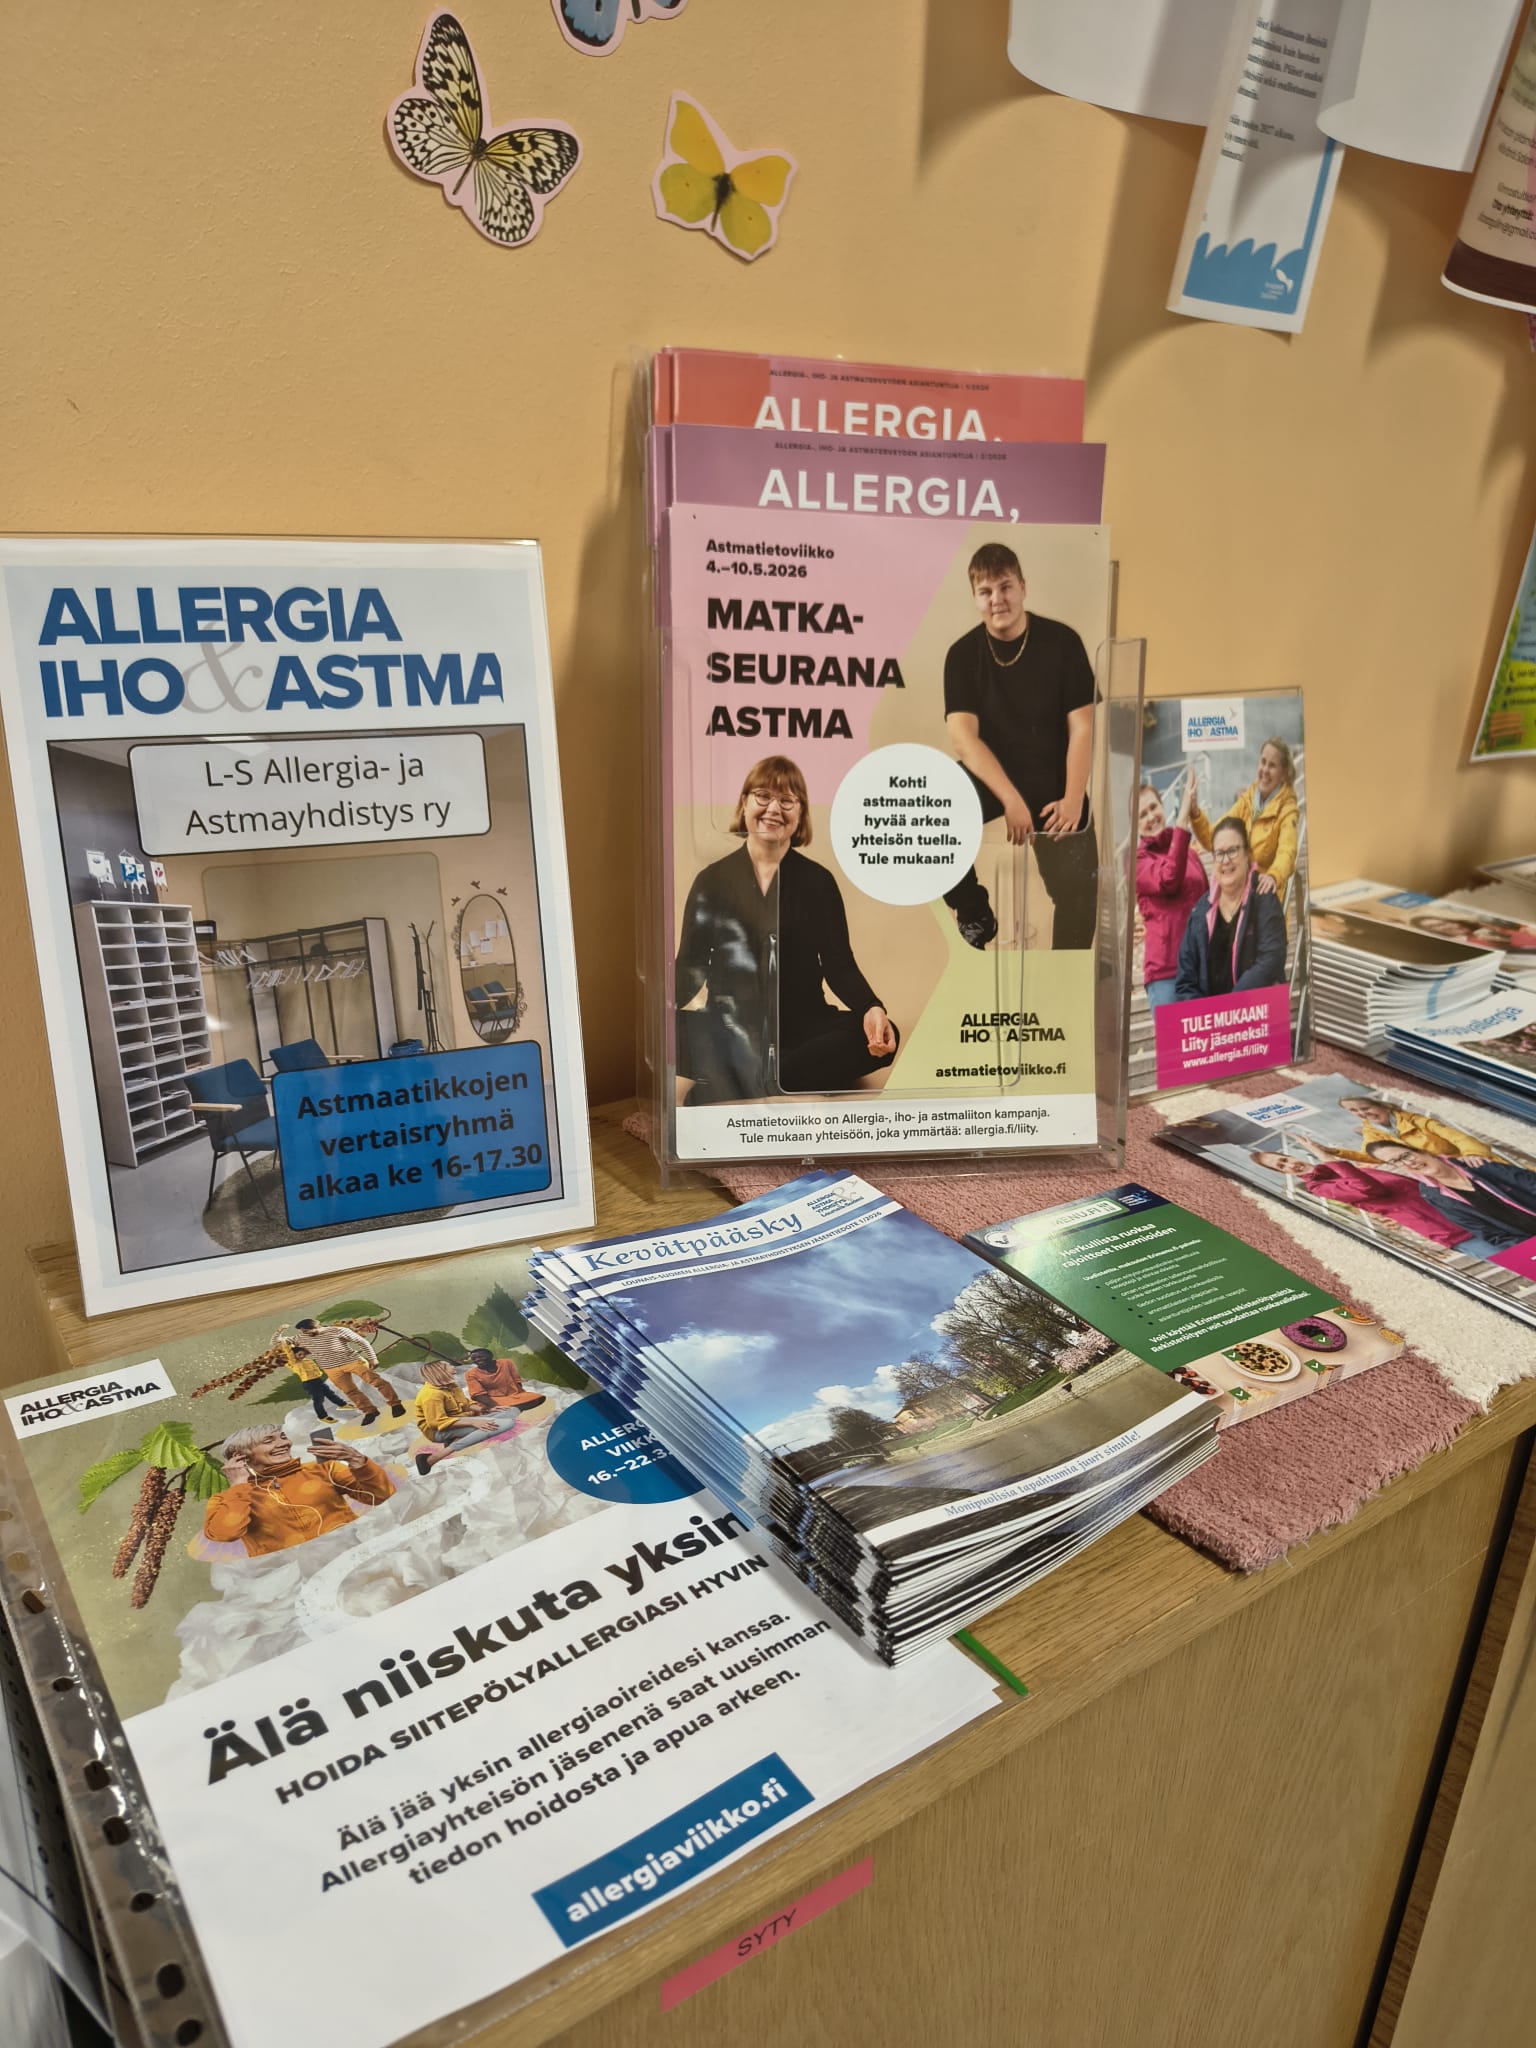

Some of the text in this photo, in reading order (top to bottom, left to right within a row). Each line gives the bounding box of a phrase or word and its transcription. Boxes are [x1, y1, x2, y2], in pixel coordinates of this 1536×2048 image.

[758, 468, 1020, 524] ALLERGIA,
[705, 538, 835, 560] Astmatietoviikko
[38, 586, 403, 646] ALLERGIA
[707, 597, 864, 635] MATKA-
[39, 656, 186, 719] IHO
[265, 652, 505, 711] ASTMA
[706, 651, 906, 689] SEURANA
[705, 705, 853, 739] ASTMA
[1187, 715, 1226, 727] ALLERGIA
[1210, 726, 1239, 736] ASTMA
[205, 752, 425, 789] L-S Allergia- ja
[889, 775, 927, 788] Kohti
[185, 800, 451, 838] Astmayhdistys ry
[863, 795, 952, 808] astmaatikon
[851, 833, 962, 848] yhteisön tuella.
[864, 814, 950, 829] hyvää arkea
[858, 852, 955, 865] Tule mukaan!
[960, 1028, 1066, 1043] IHO ASTMA
[961, 1012, 1040, 1028] ALLERGIA
[1181, 1004, 1268, 1034] TULE MUKAAN!
[1181, 1023, 1268, 1053] Liity jäseneksi!
[935, 1062, 1066, 1078] astmatietoviikko.fi
[1182, 1043, 1268, 1068] www.allergia.fi/liity
[297, 1070, 529, 1120] Astmaatikkojen
[319, 1108, 515, 1157] vertaisryhmä
[726, 1107, 1050, 1129] Astmatietoviikko on Allergia-, iho- ja astmaliiton kampanja.
[740, 1123, 1039, 1143] Tule mukaan yhteisöön, joka ymmärtää: allergia.fi/liity.
[297, 1143, 543, 1201] alkaa ke 16-17.30
[582, 1211, 803, 1273] Kevätpääsky
[1060, 1222, 1157, 1258] Herkullista ruokaa
[1062, 1243, 1114, 1268] rajoitteet
[1113, 1227, 1177, 1252] huomioiden
[621, 1269, 692, 1287] LOUNAIS-SUOMEN
[730, 1259, 740, 1268] JA
[740, 1241, 811, 1265] ASTMAYHDISTYKSEN
[20, 1381, 123, 1415] ALLERGIA
[21, 1406, 64, 1426] IHO
[84, 1381, 162, 1410] ASTMA
[944, 1430, 1142, 1517] Monipuolisia tapahtumia juuri sinulle!
[203, 1511, 750, 1786] Älä niiskuta yksin
[275, 1554, 770, 1805] HOIDA SIITEPÖLYALLERGIASI HYVIN
[337, 1611, 791, 1851] Älä jää yksin allergiaoireidesi kanssa.
[322, 1618, 832, 1892] Allergiayhteisön jäsenenä saat uusimman
[408, 1669, 801, 1885] tiedon hoidosta ja apua arkeen.
[565, 1776, 789, 1923] allergiaviikko.fi
[737, 1909, 798, 1958] SYTY
